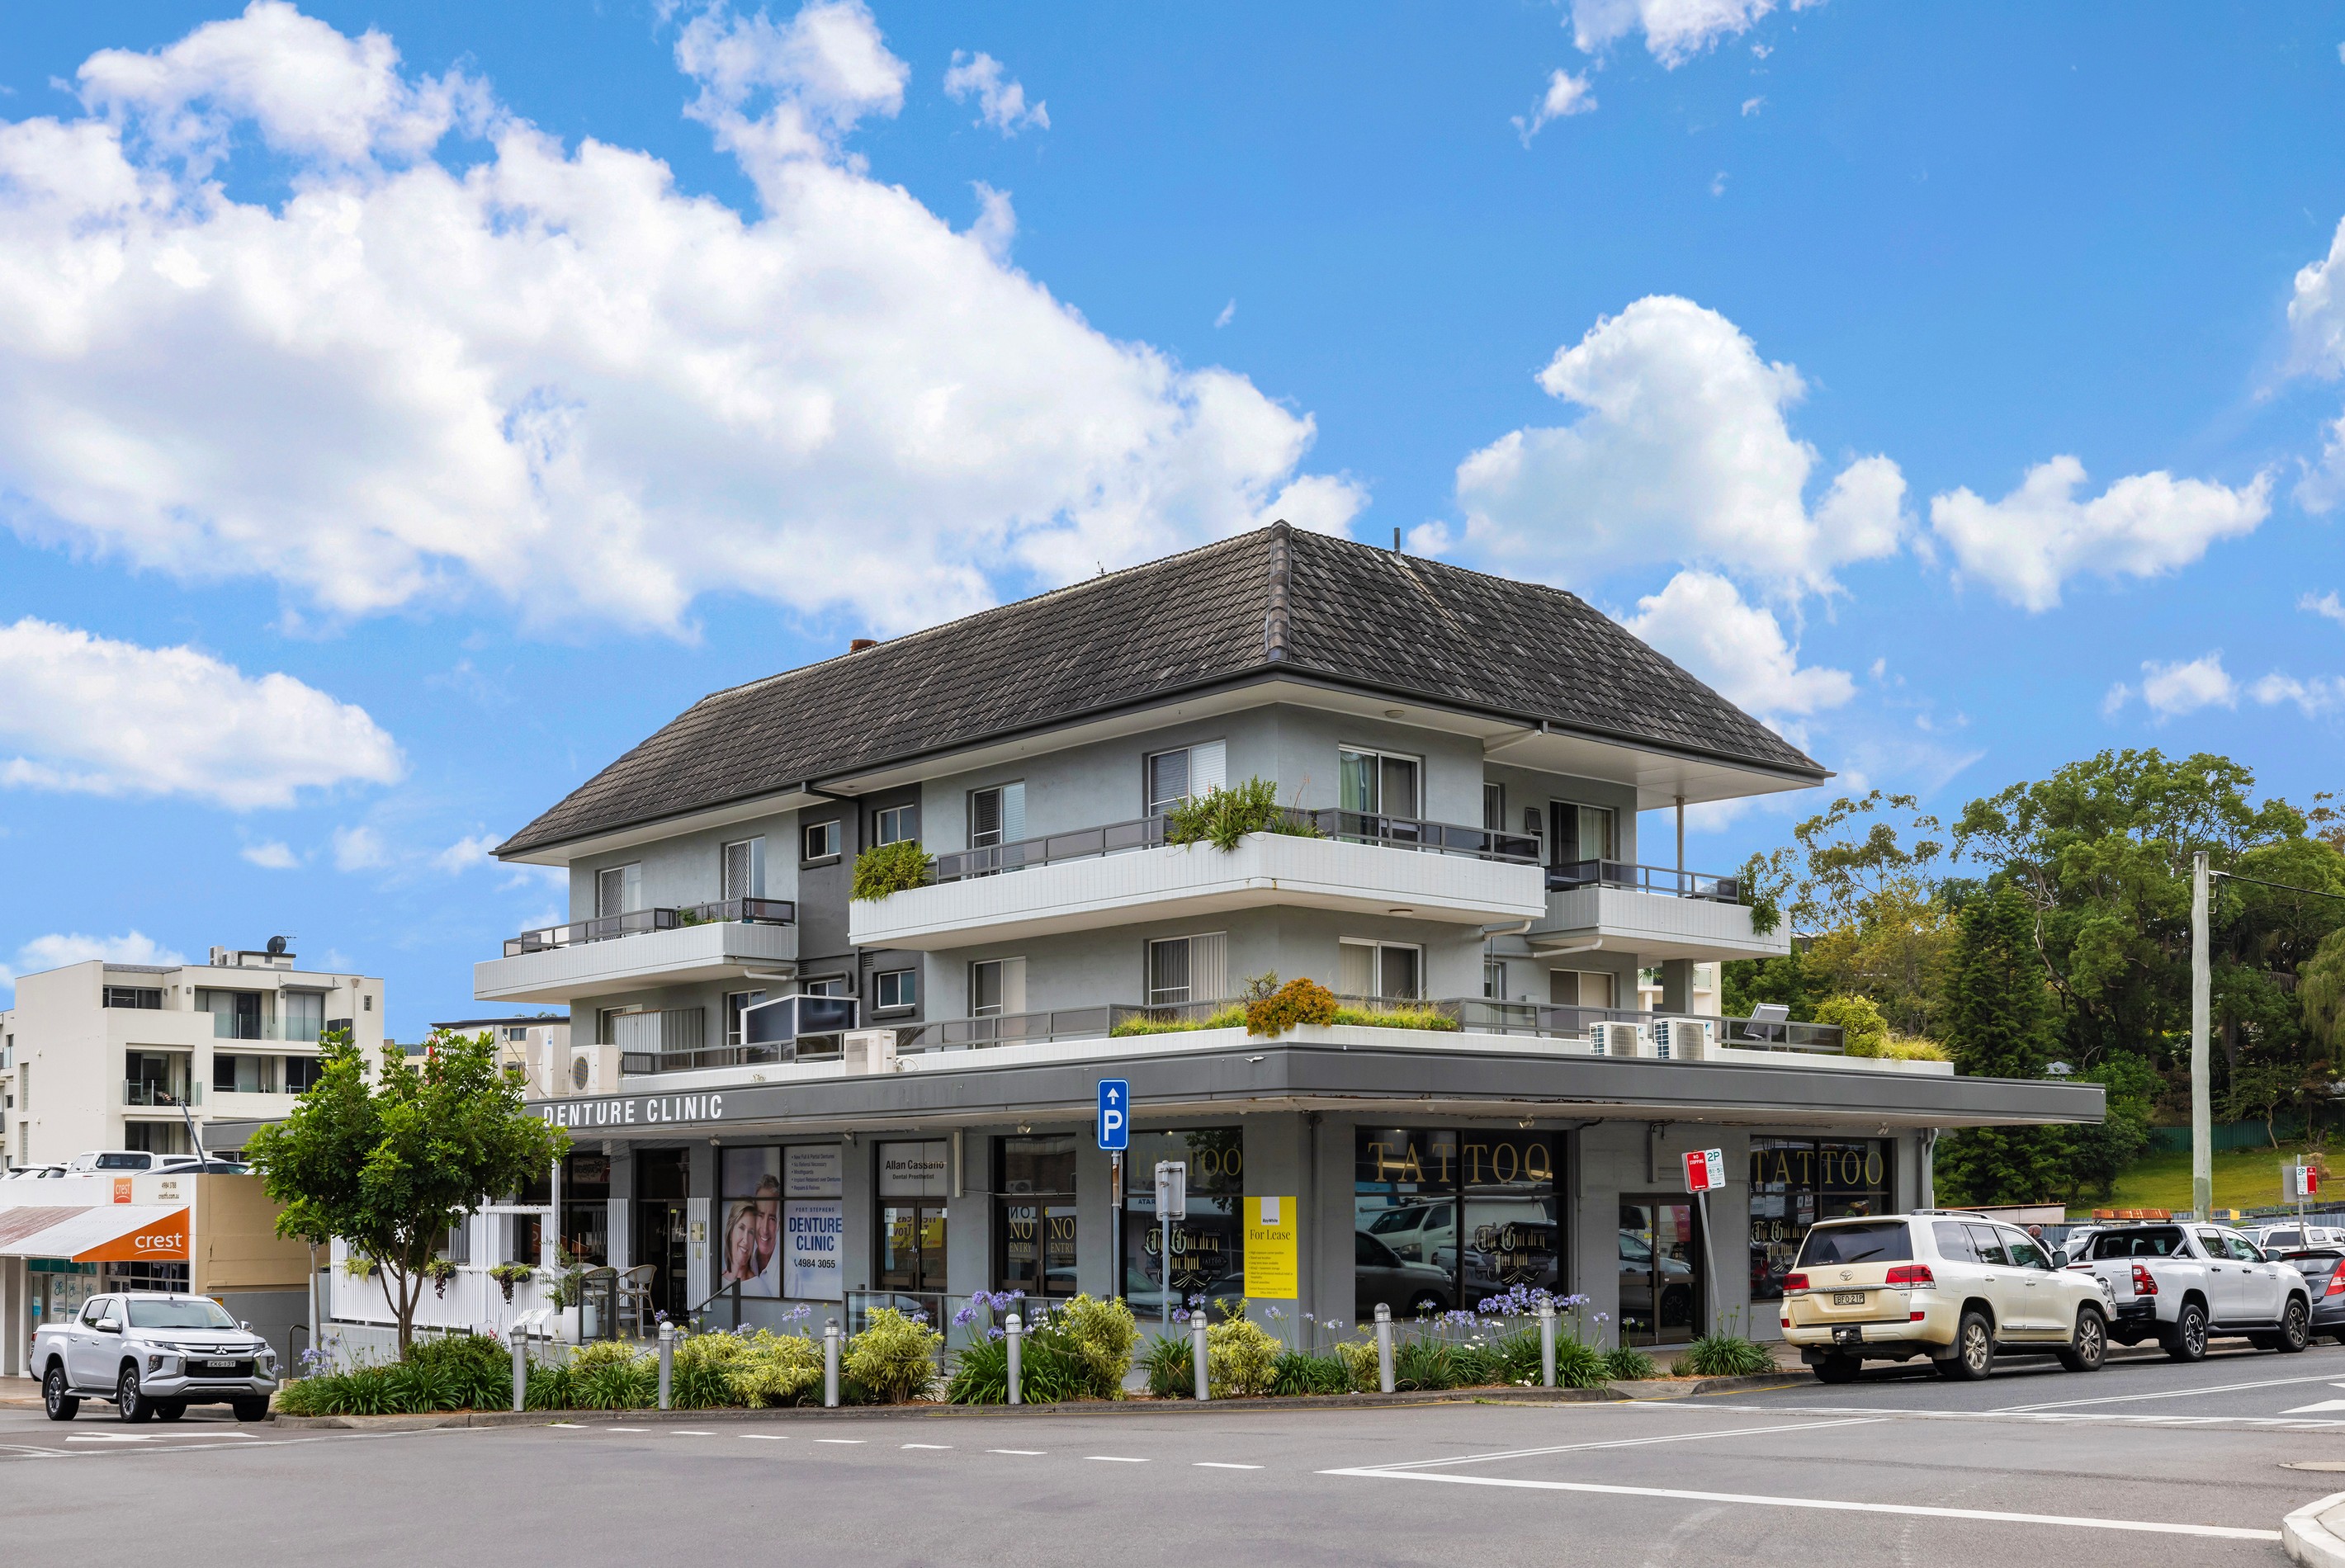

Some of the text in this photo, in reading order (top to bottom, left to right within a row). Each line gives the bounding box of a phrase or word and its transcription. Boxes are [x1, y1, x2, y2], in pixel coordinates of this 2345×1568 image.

[544, 1095, 722, 1126] DENTURE CLINIC
[1104, 1110, 1123, 1141] P
[1368, 1142, 1550, 1183] TATTOO
[1707, 1151, 1720, 1162] 2P
[886, 1160, 944, 1170] Allan Cassano
[1750, 1150, 1884, 1185] TATTOO
[115, 1183, 130, 1194] crest
[789, 1217, 842, 1233] DENTURE
[1010, 1219, 1033, 1239] NO
[1051, 1218, 1074, 1239] NO
[135, 1232, 183, 1248] crest
[1250, 1229, 1290, 1240] For Lease
[796, 1235, 834, 1251] CLINIC
[1010, 1242, 1032, 1252] ENTRY
[1051, 1243, 1074, 1253] ENTRY
[798, 1259, 835, 1268] 4984 3055
